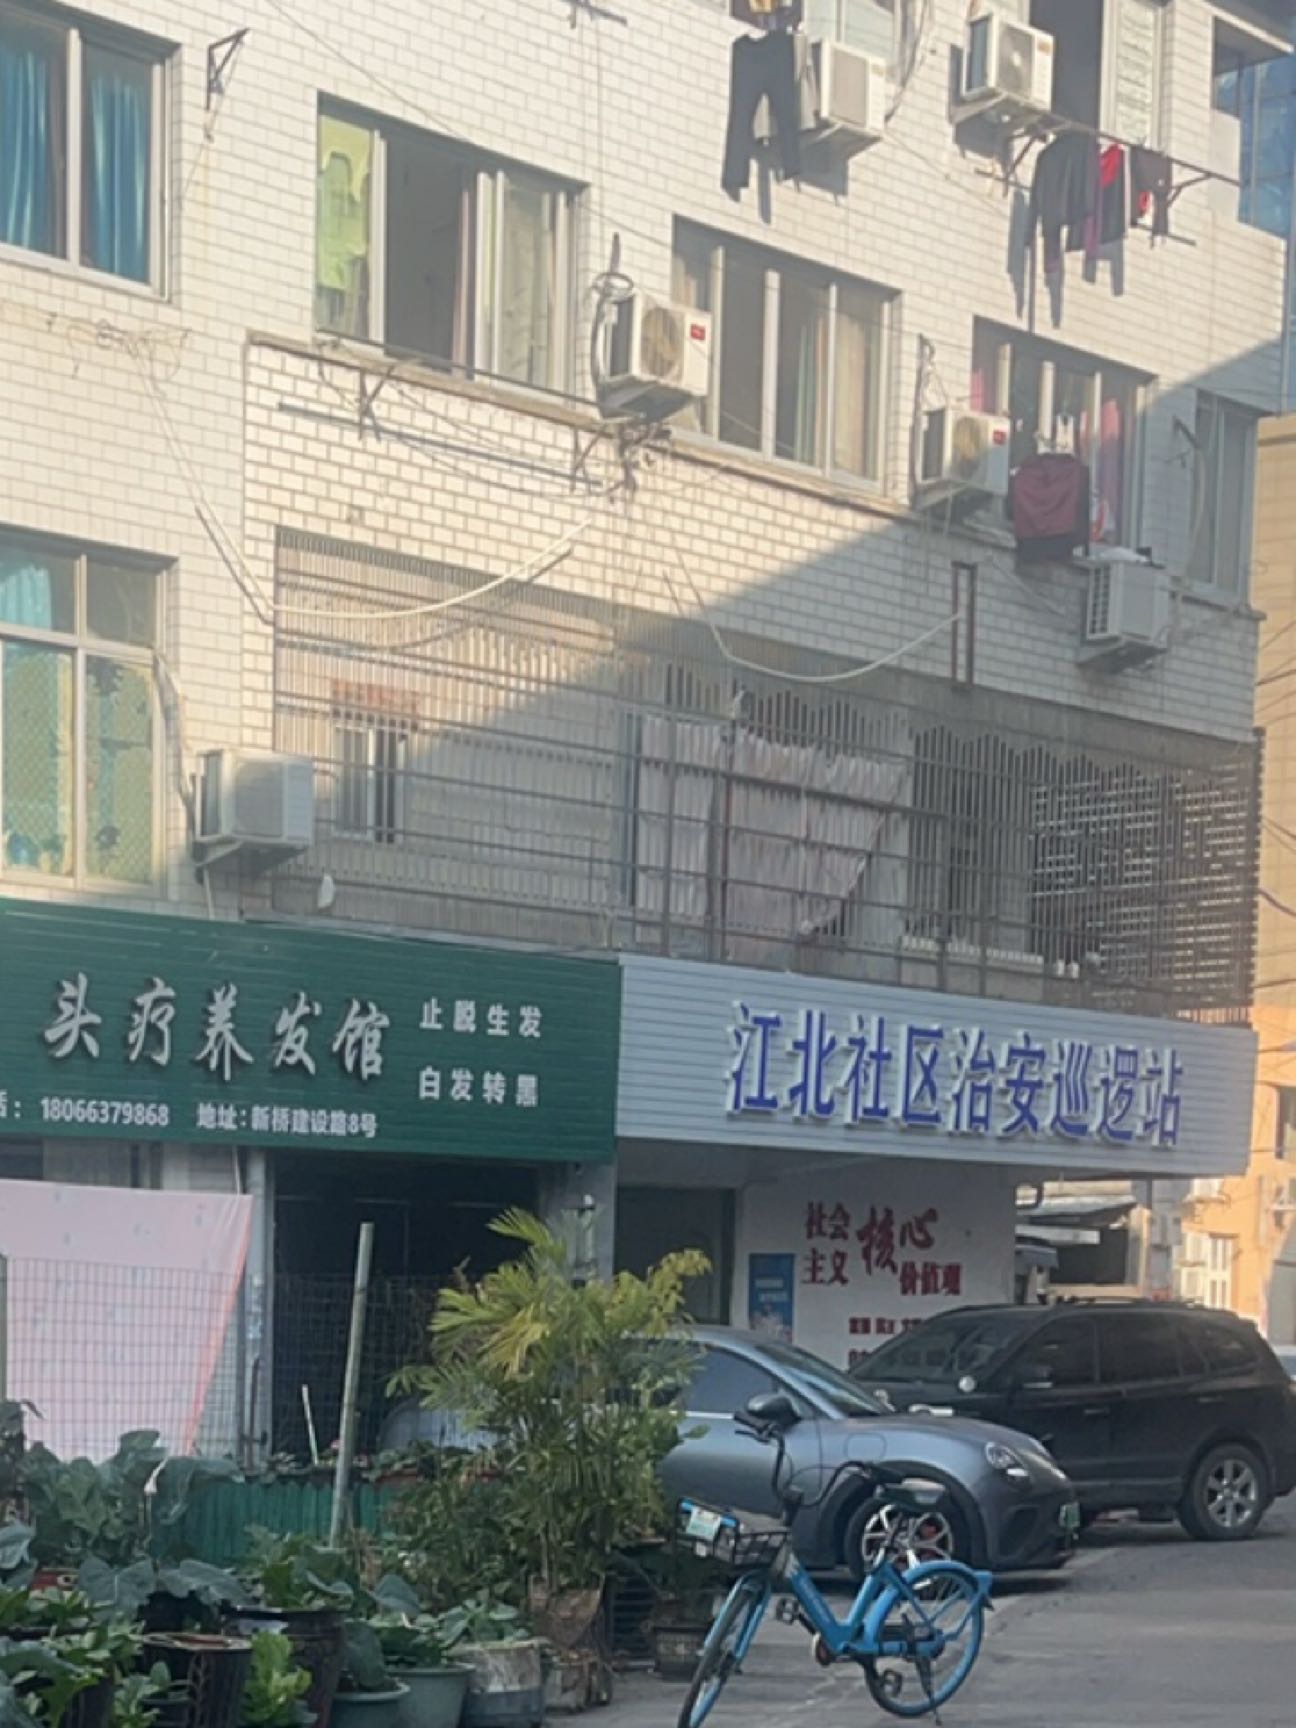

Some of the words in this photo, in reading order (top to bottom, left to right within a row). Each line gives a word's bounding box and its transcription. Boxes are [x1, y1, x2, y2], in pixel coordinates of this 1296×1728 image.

[45, 972, 390, 1080] 头疗养发馆
[419, 997, 542, 1037] 止脱生发
[419, 1065, 539, 1107] 白发转黑
[727, 1002, 1183, 1146] 江北社区治安巡逻站
[40, 1097, 170, 1127] 18066379868
[806, 1201, 851, 1240] 社会
[857, 1206, 938, 1276] 核心
[804, 1247, 849, 1285] 主义
